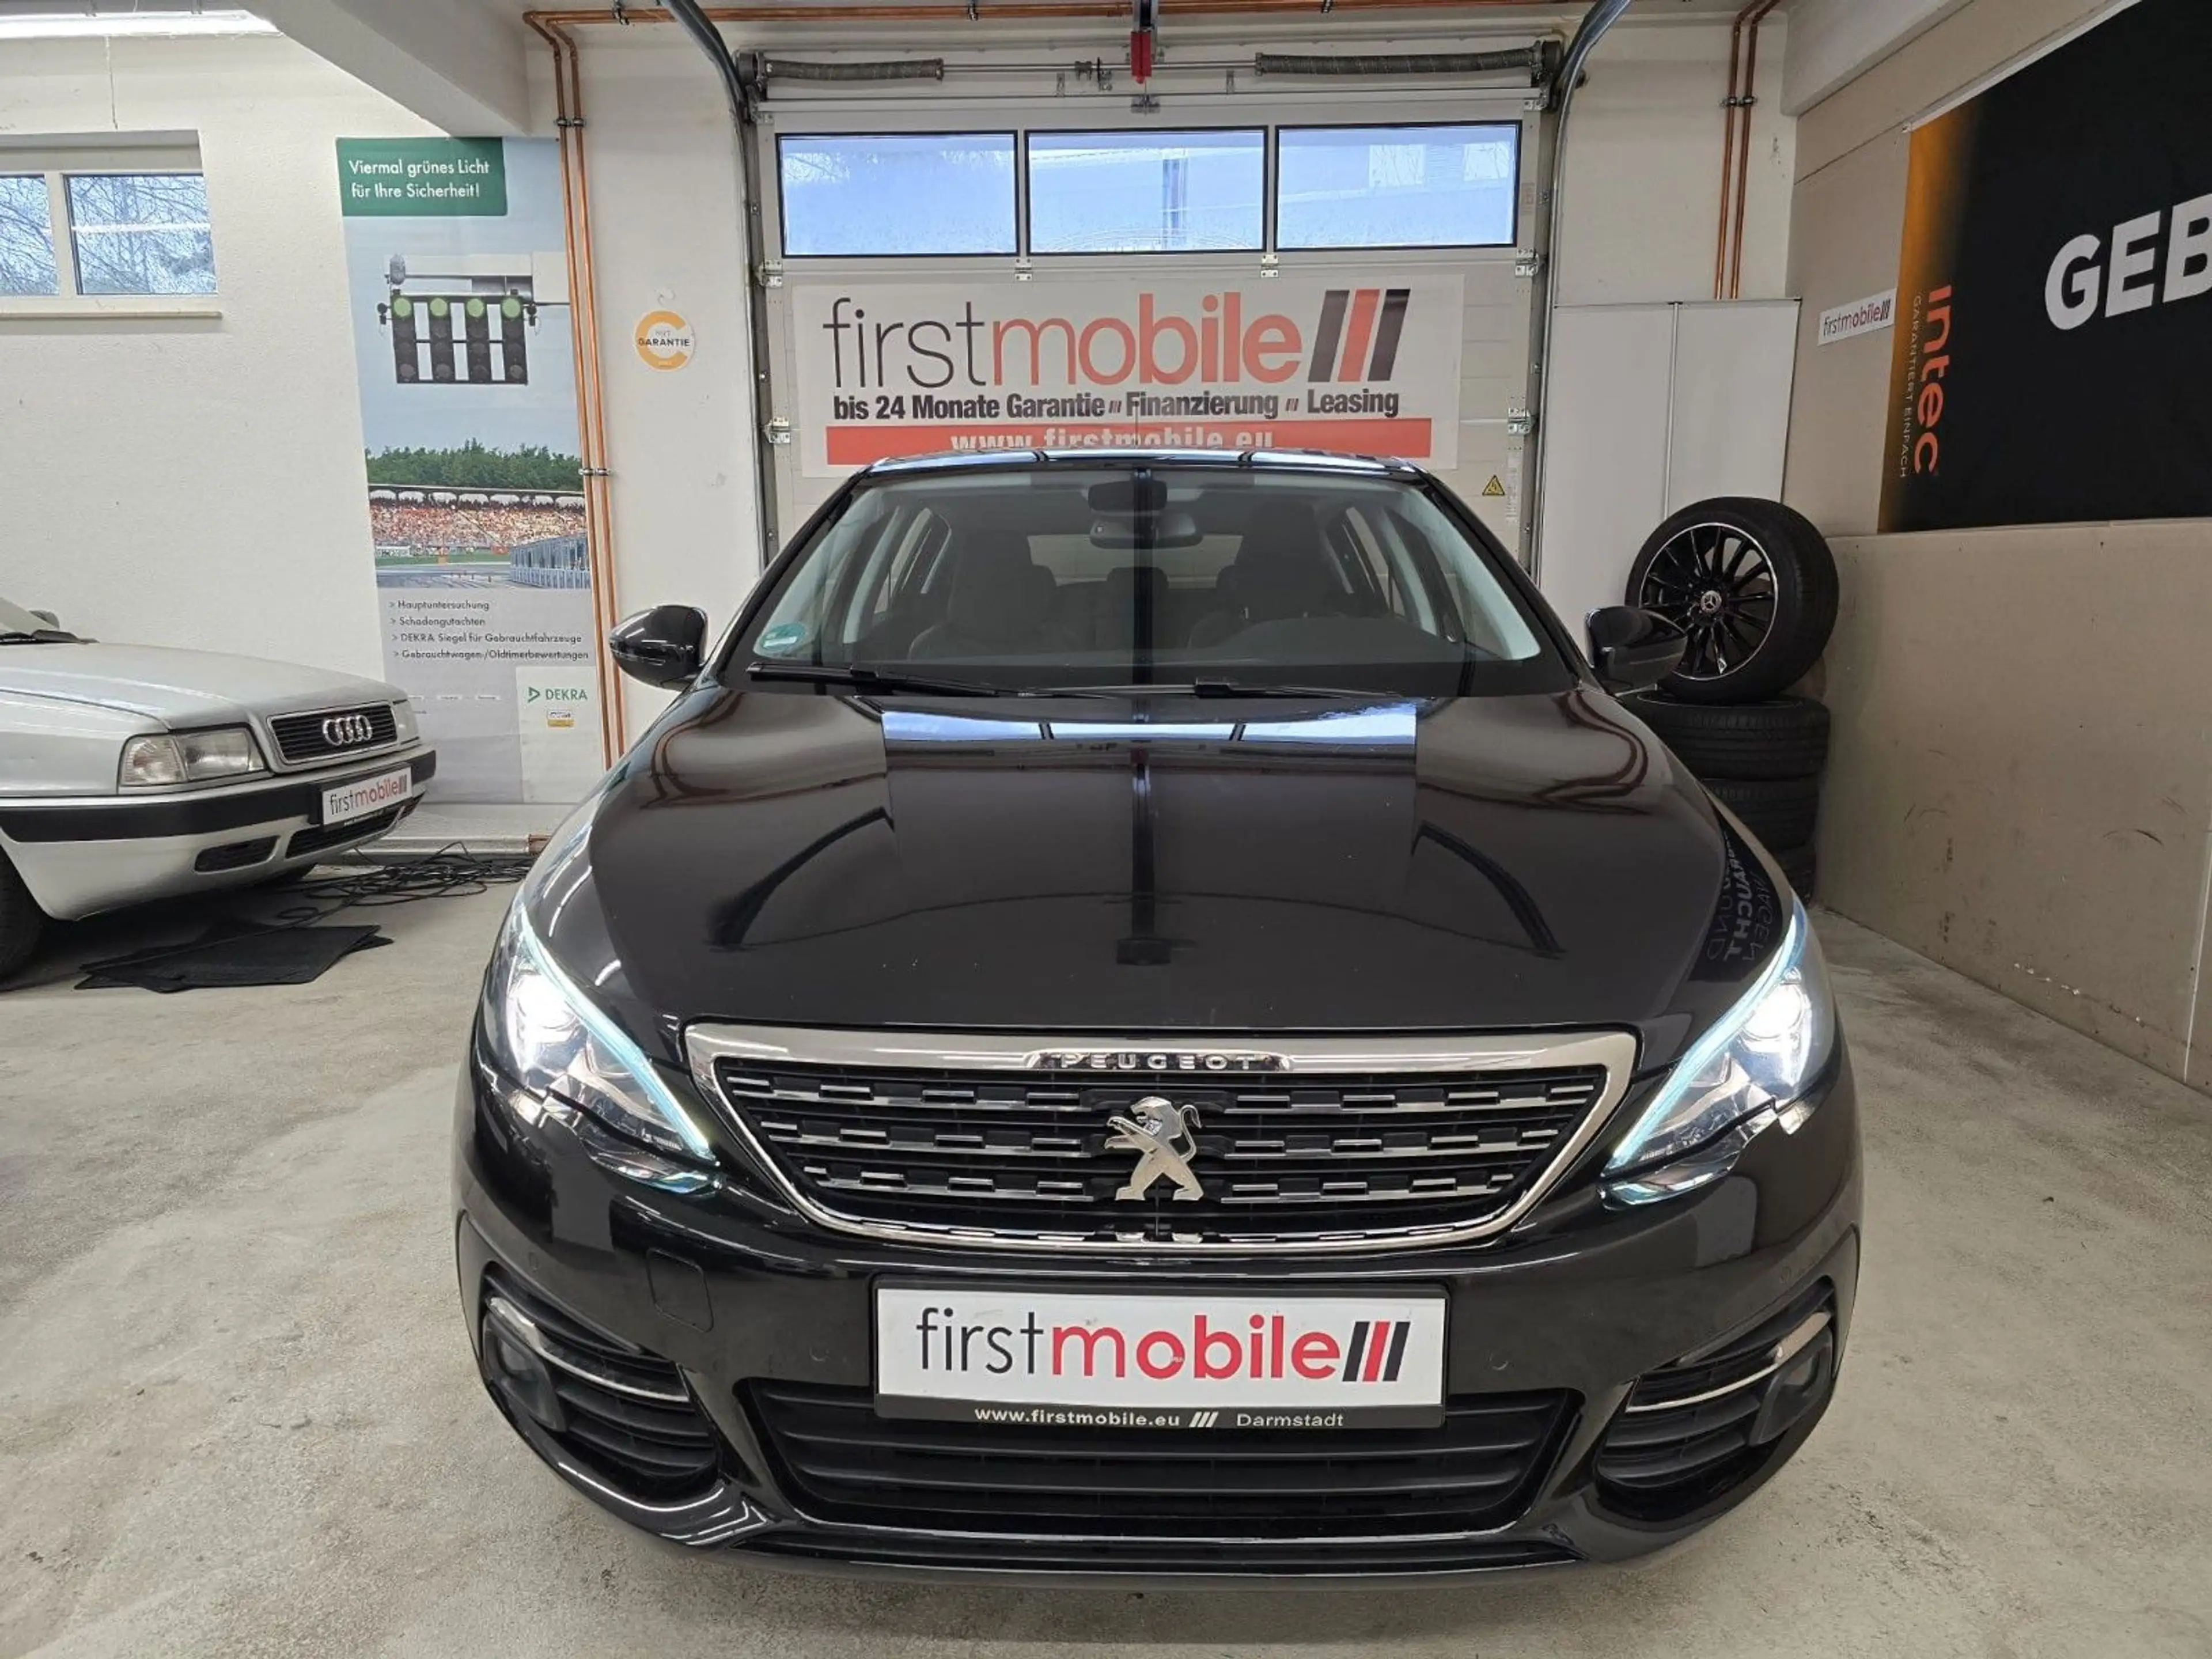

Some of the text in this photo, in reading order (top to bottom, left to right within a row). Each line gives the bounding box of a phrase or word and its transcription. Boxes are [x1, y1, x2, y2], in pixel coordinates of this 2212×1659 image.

[349, 158, 490, 177] Viermal grünes Licht
[352, 182, 479, 198] für Ihre Sicherheit!
[1823, 304, 1881, 337] firstmobile
[639, 338, 690, 346] GARANTIE
[823, 293, 1303, 388] firstmobile
[834, 388, 1400, 422] bis 24 Monate Garantie Finanzierung Leasing
[951, 427, 1272, 449] wwwfirstmobileeu
[397, 600, 489, 611] Hauptuntersuchung
[401, 634, 433, 642] DEKRA
[438, 634, 467, 643] Siegel
[469, 633, 483, 642] für
[546, 689, 588, 701] DEKRA
[330, 778, 397, 815] firstmobile
[1059, 1054, 1255, 1070] PEUGEOT
[917, 1307, 1340, 1380] firstmobile
[975, 1407, 1343, 1427] www.firstmobile.eu Darmstadt
